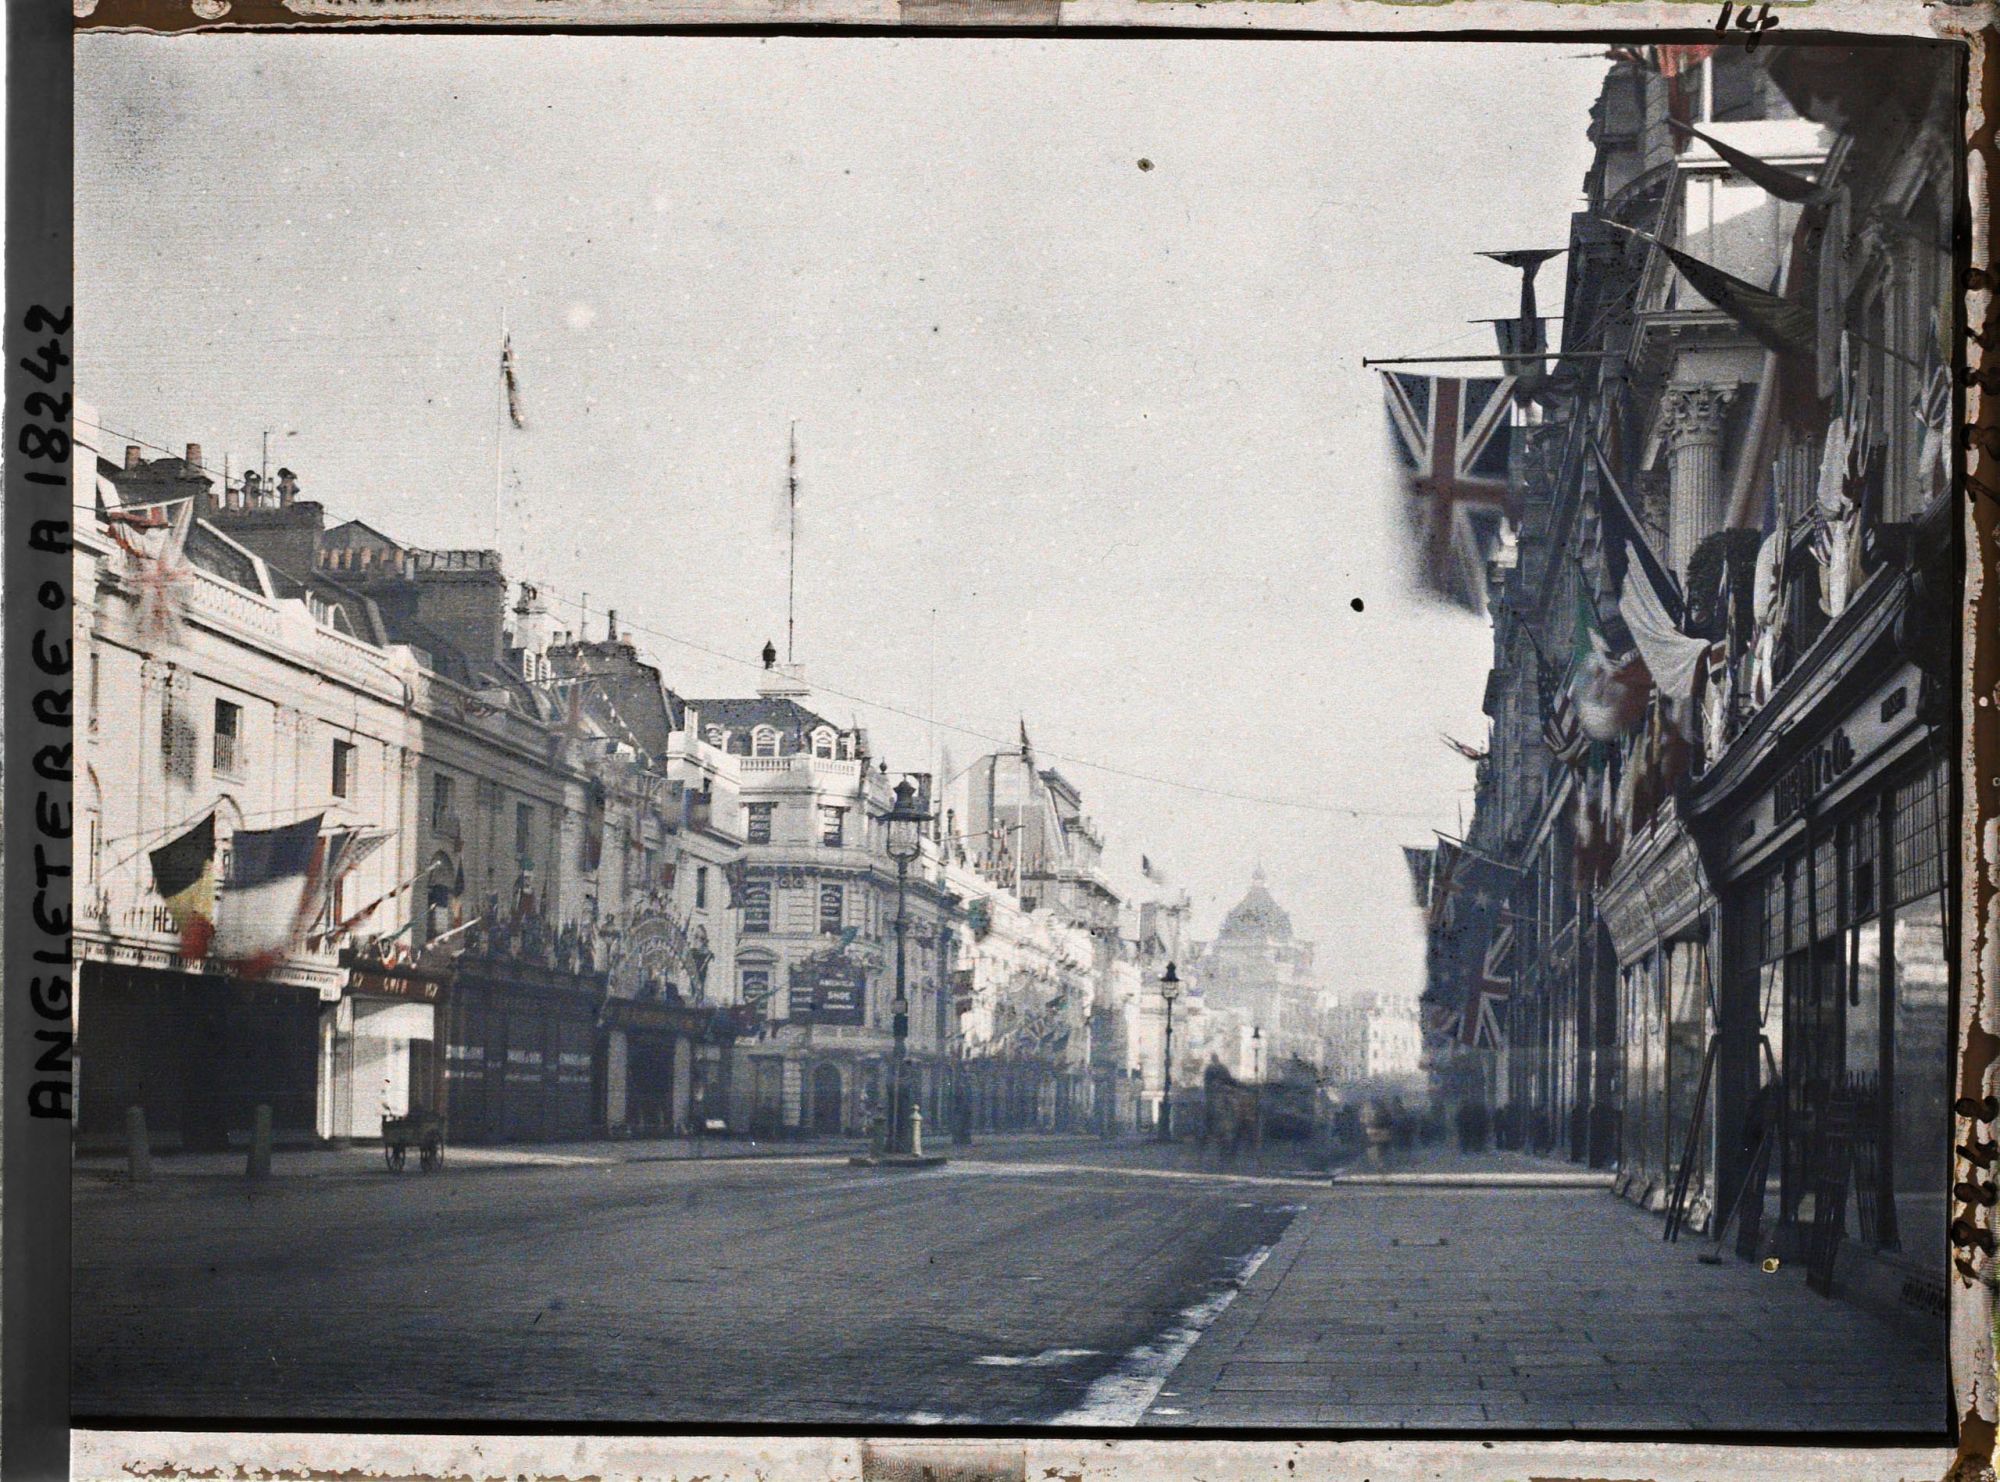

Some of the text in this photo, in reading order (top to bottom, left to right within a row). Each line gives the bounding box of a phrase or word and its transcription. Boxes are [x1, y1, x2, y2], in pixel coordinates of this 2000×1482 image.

[1715, 1, 1779, 53] 14
[18, 304, 73, 486] 18242
[27, 629, 73, 1120] ANGLETERRE
